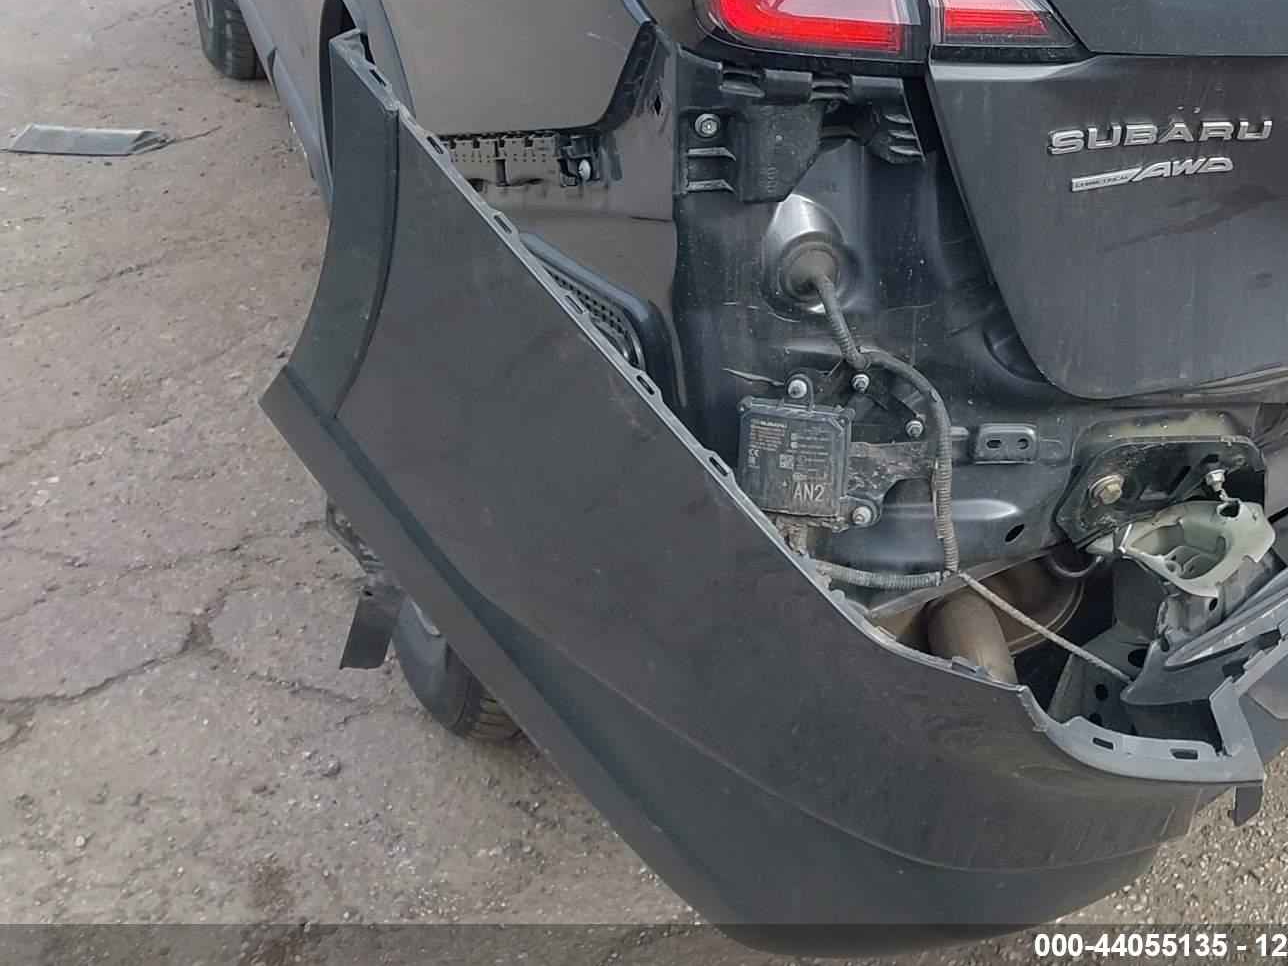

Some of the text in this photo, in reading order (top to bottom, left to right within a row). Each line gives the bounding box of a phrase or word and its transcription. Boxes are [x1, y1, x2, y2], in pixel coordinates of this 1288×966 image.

[1050, 120, 1272, 155] SUBARU
[1131, 156, 1233, 182] AWD
[793, 482, 825, 502] AN2
